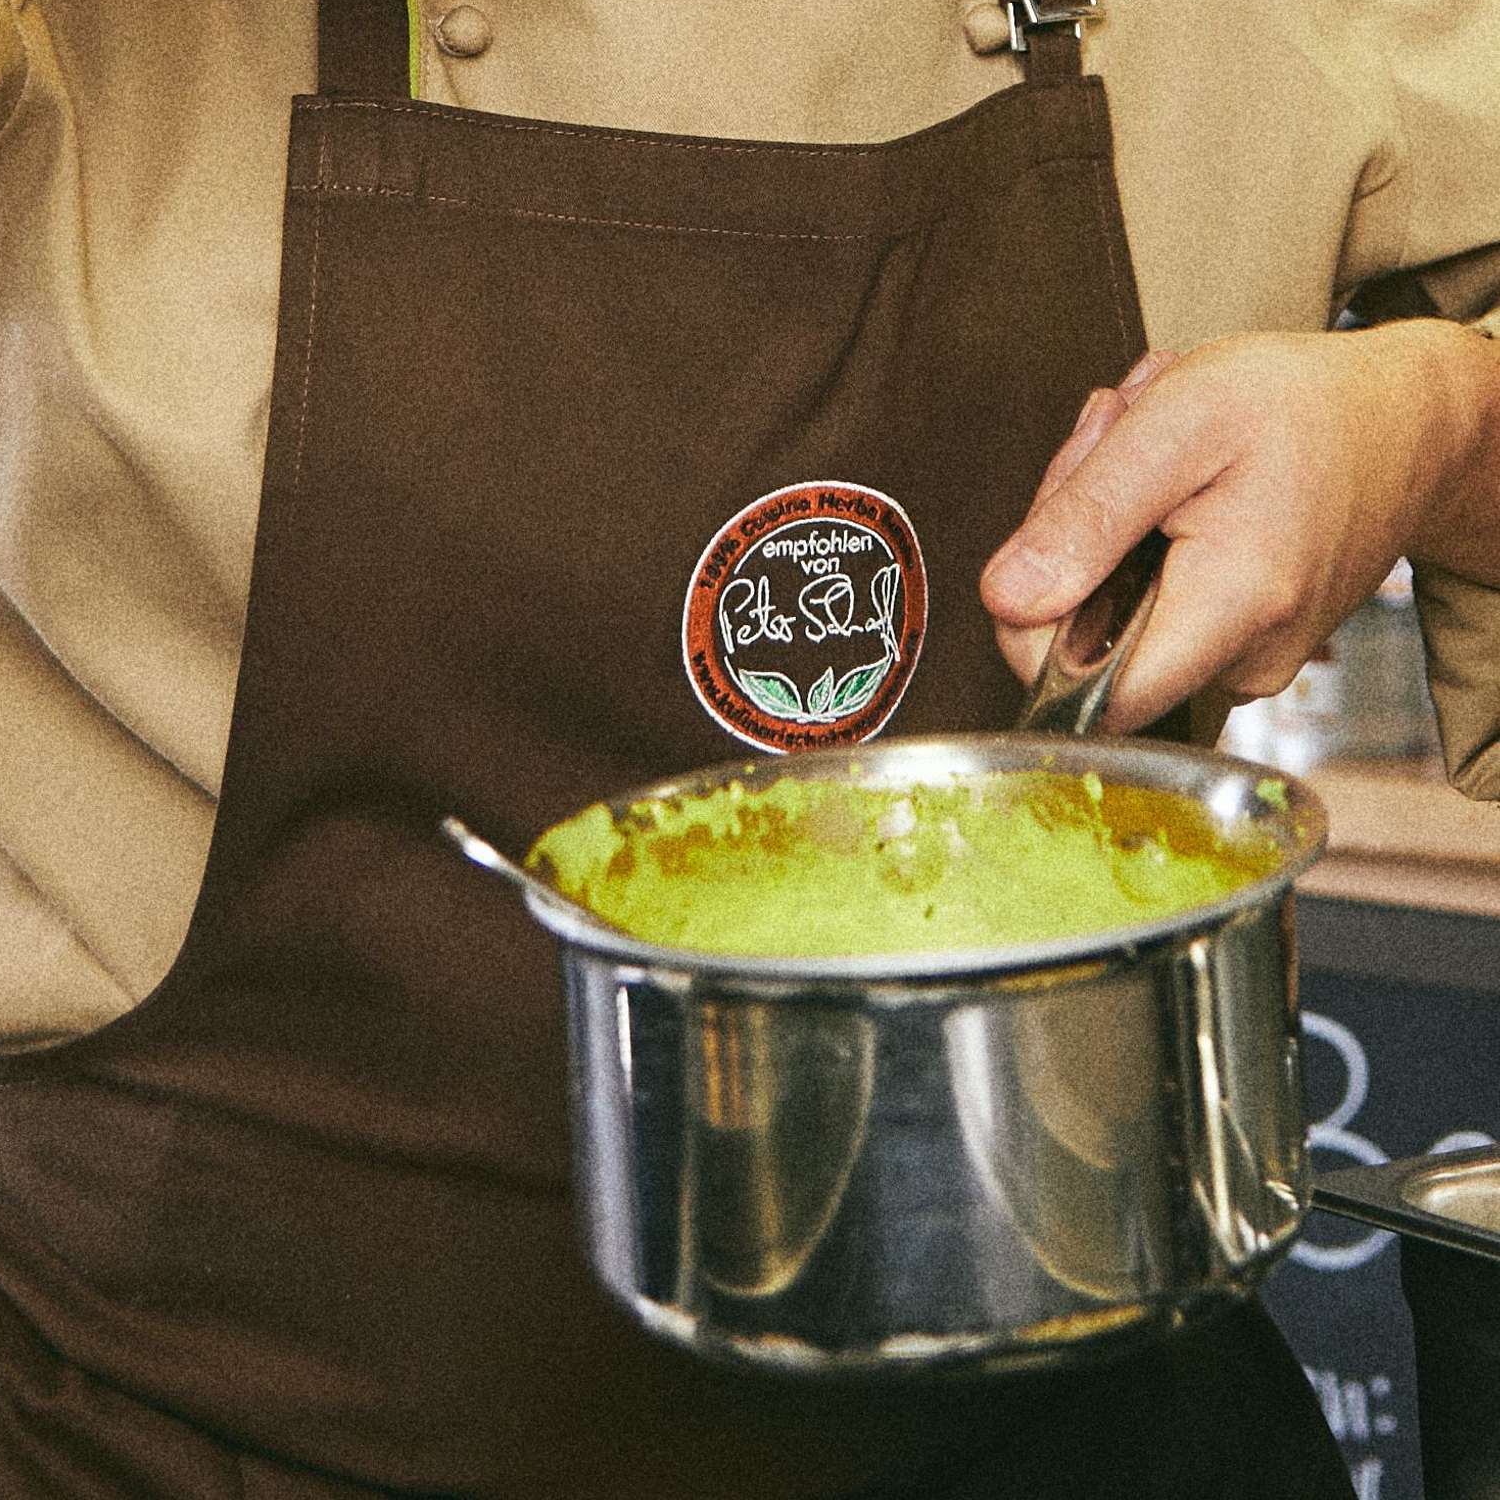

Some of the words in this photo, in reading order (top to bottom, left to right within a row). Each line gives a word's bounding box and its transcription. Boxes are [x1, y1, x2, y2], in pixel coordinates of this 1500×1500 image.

[817, 492, 878, 520] Herba
[762, 529, 873, 563] empfohlen
[800, 557, 841, 576] von
